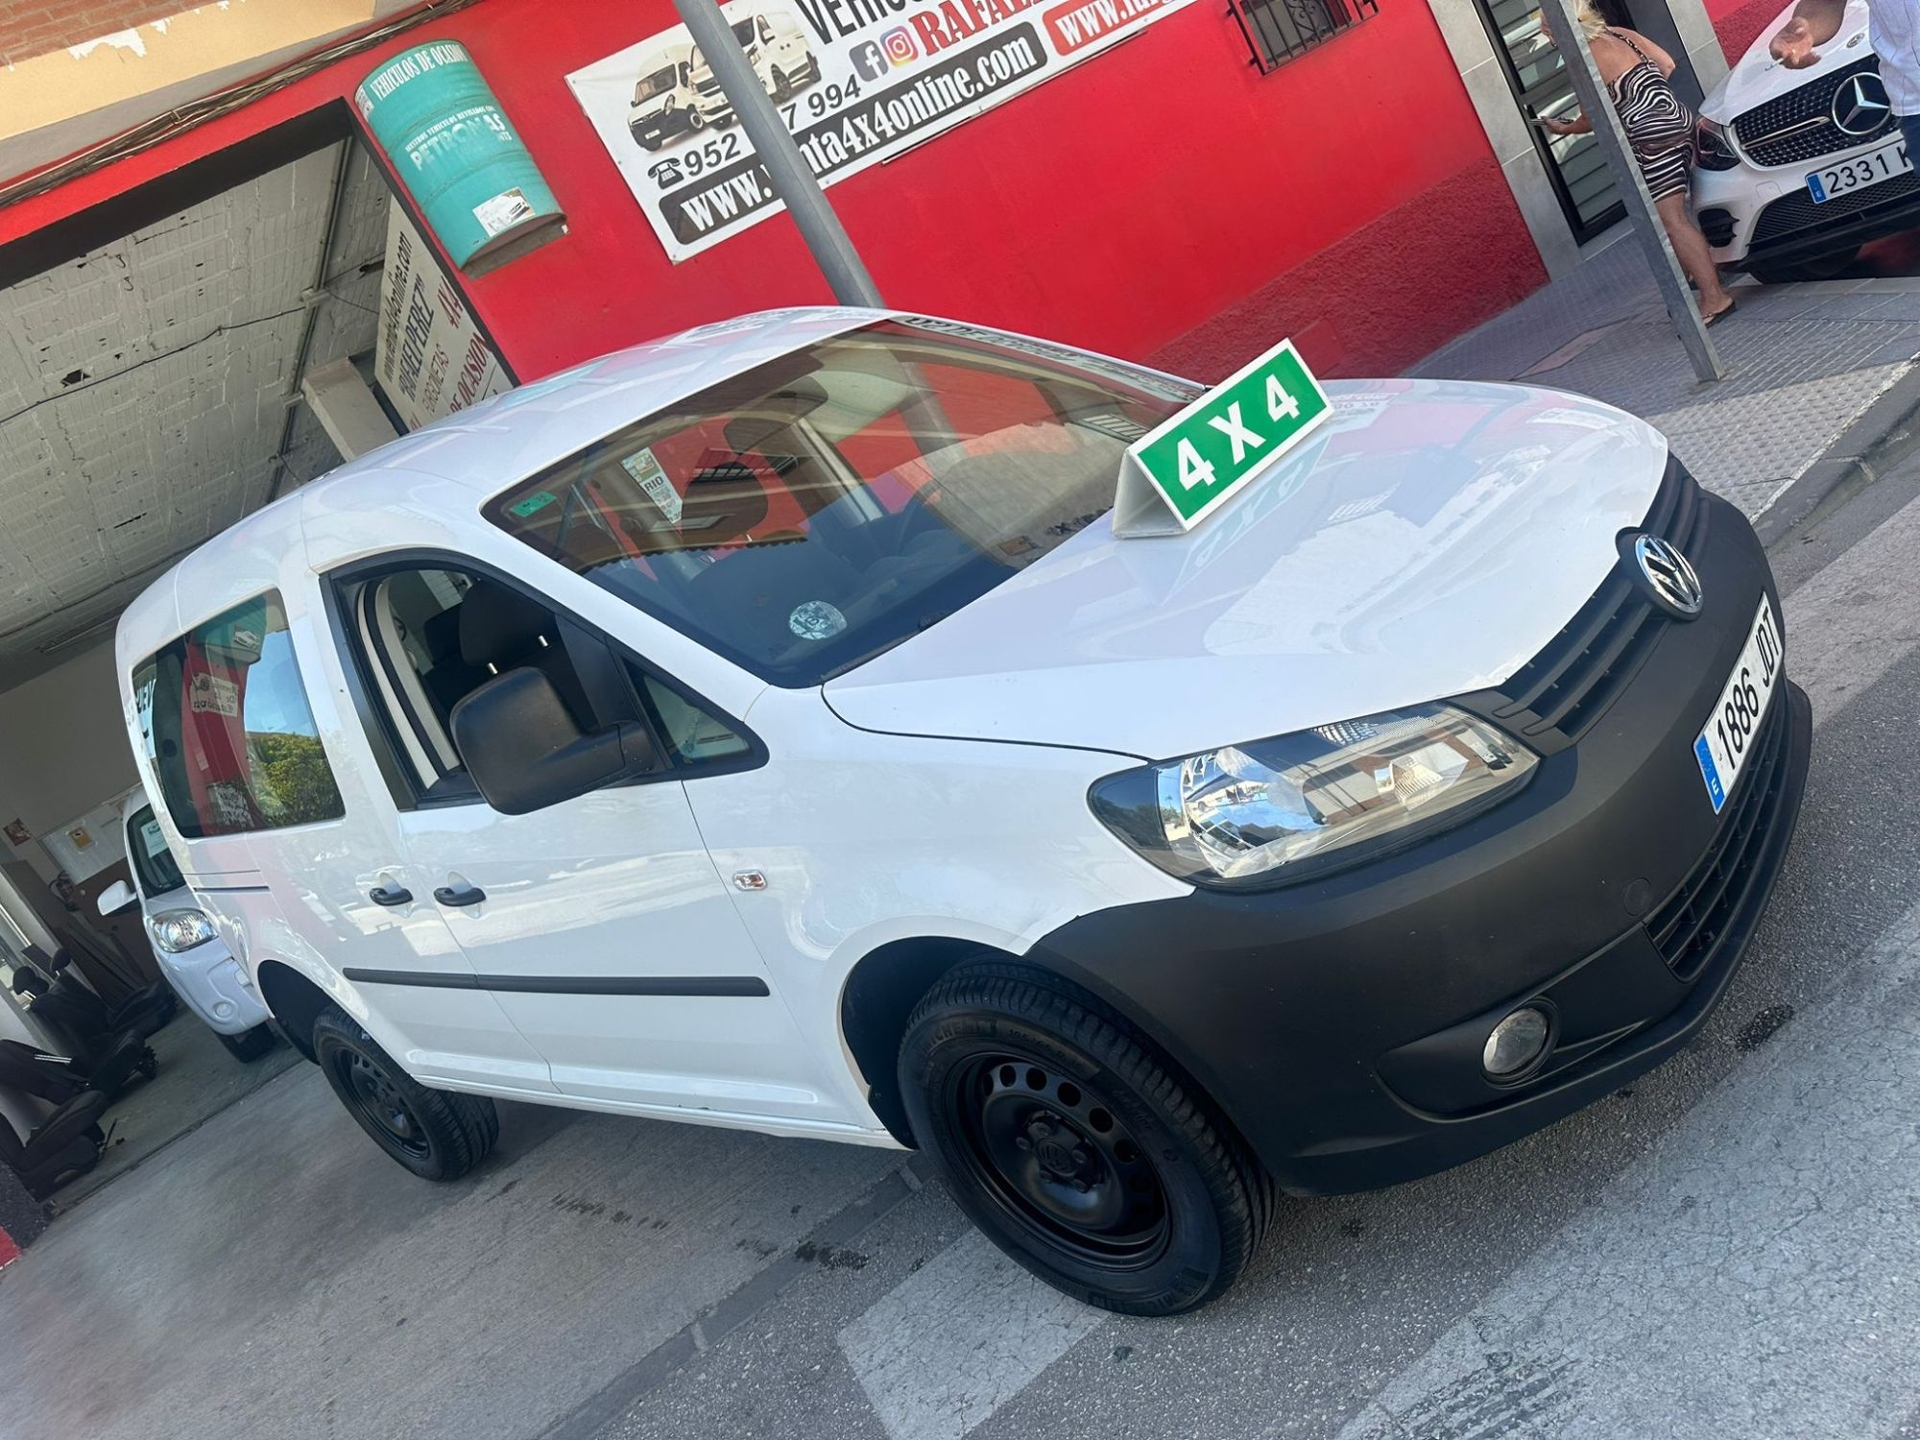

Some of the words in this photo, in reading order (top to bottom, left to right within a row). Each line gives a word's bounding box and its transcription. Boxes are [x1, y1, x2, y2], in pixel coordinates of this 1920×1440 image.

[369, 56, 421, 101] VEHICULOS
[414, 50, 436, 72] DE
[680, 36, 1038, 232] www.nta4x4online.com
[684, 132, 742, 177] 952
[807, 74, 862, 118] 994
[1824, 153, 1890, 194] 2331
[643, 475, 665, 492] RIO
[1717, 666, 1760, 771] 1886
[1755, 605, 1780, 688] JDT
